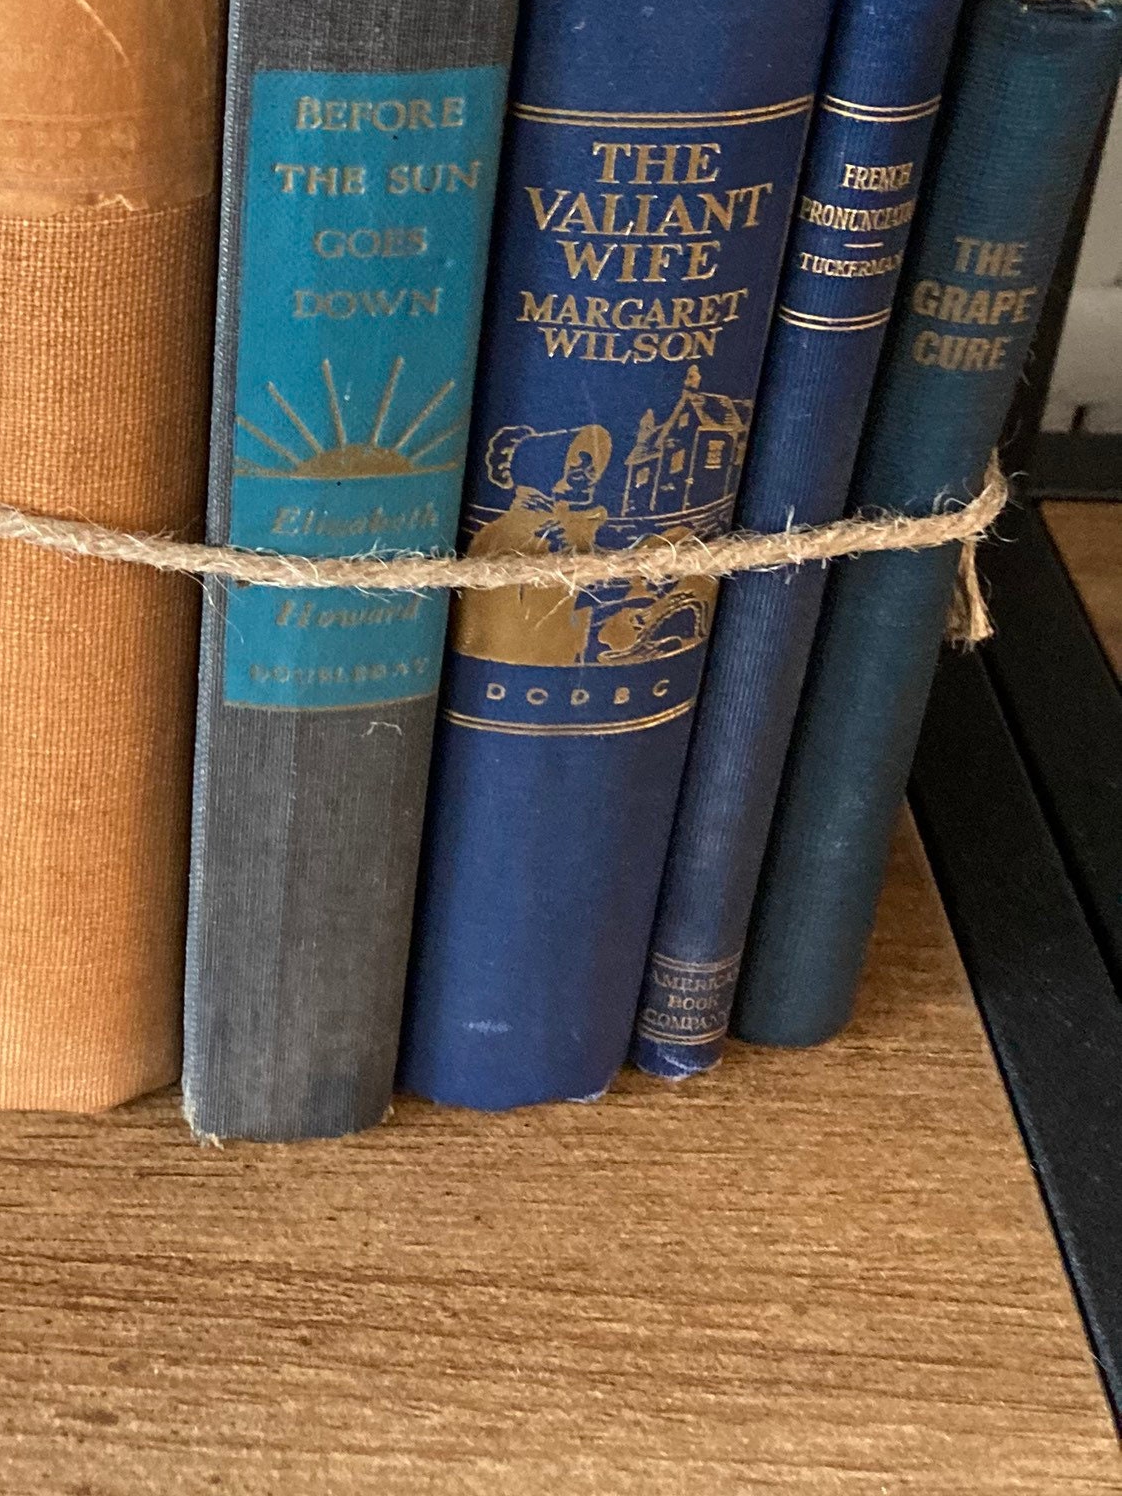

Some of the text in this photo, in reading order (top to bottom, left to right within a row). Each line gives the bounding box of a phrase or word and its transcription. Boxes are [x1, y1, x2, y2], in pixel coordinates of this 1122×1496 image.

[295, 96, 466, 132] BEFORE
[274, 160, 482, 195] THE SUN
[592, 142, 722, 185] THE
[841, 162, 914, 192] FRENCH
[524, 182, 774, 236] VALIANT
[313, 227, 429, 259] GOES
[556, 239, 722, 283] WIFE
[954, 235, 1029, 278] THE
[292, 287, 444, 319] DOWN
[516, 287, 749, 330] MARGARET
[912, 279, 1039, 326] GRAPE
[537, 326, 723, 364] WILSON
[912, 330, 1014, 372] CURE
